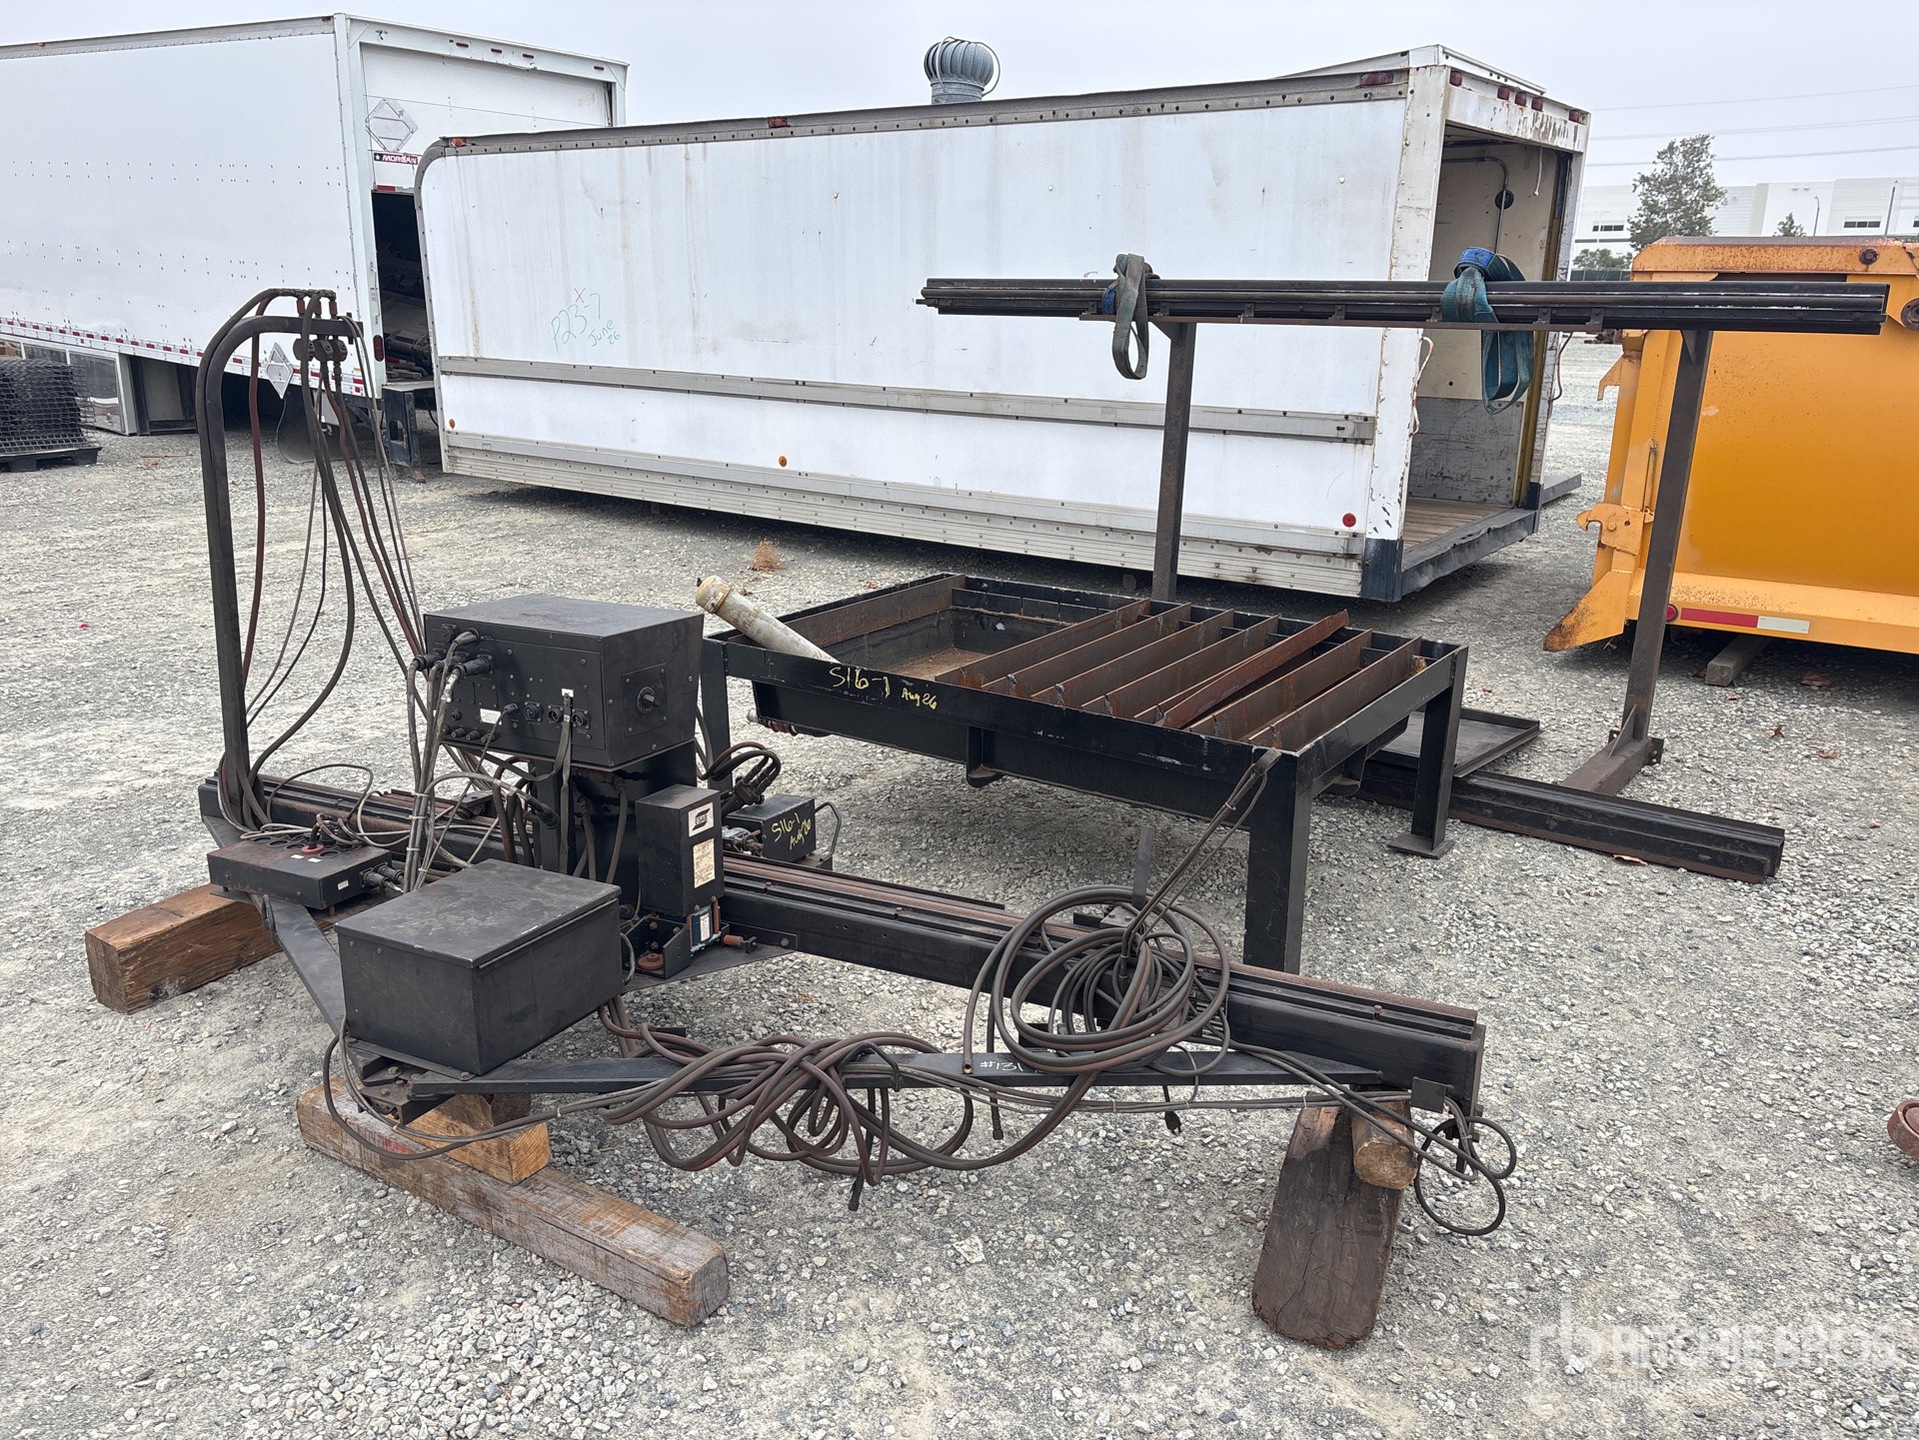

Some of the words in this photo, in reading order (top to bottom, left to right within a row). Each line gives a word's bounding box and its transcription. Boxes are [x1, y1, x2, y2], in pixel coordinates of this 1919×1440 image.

[382, 154, 417, 164] MORGAN
[587, 319, 613, 346] June
[607, 330, 621, 345] 26
[901, 687, 920, 707] Aug
[922, 692, 937, 710] 26
